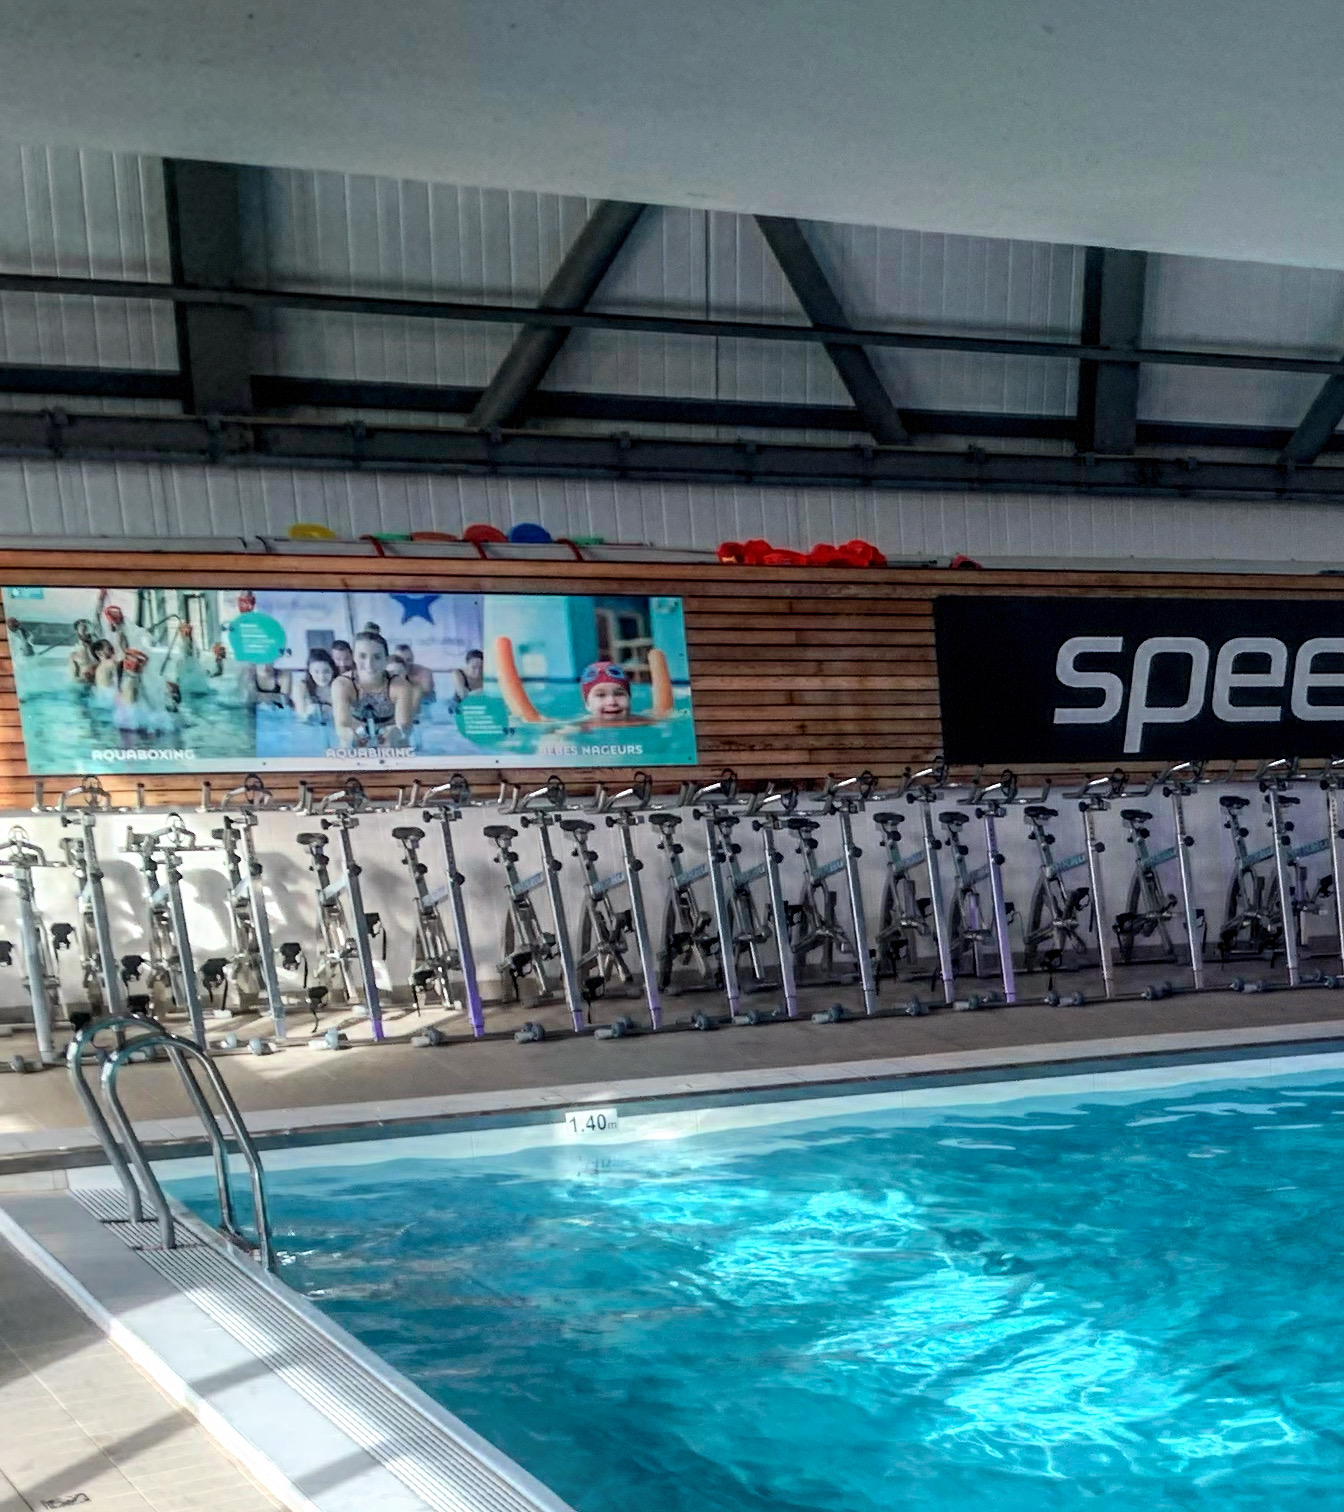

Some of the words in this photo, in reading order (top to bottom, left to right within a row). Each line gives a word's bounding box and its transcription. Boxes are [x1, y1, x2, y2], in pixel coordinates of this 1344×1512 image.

[91, 748, 196, 762] AQUABOXING
[325, 747, 417, 761] AQUABIKING
[581, 744, 643, 756] NAGEURS
[569, 1113, 618, 1133] 1.40m
